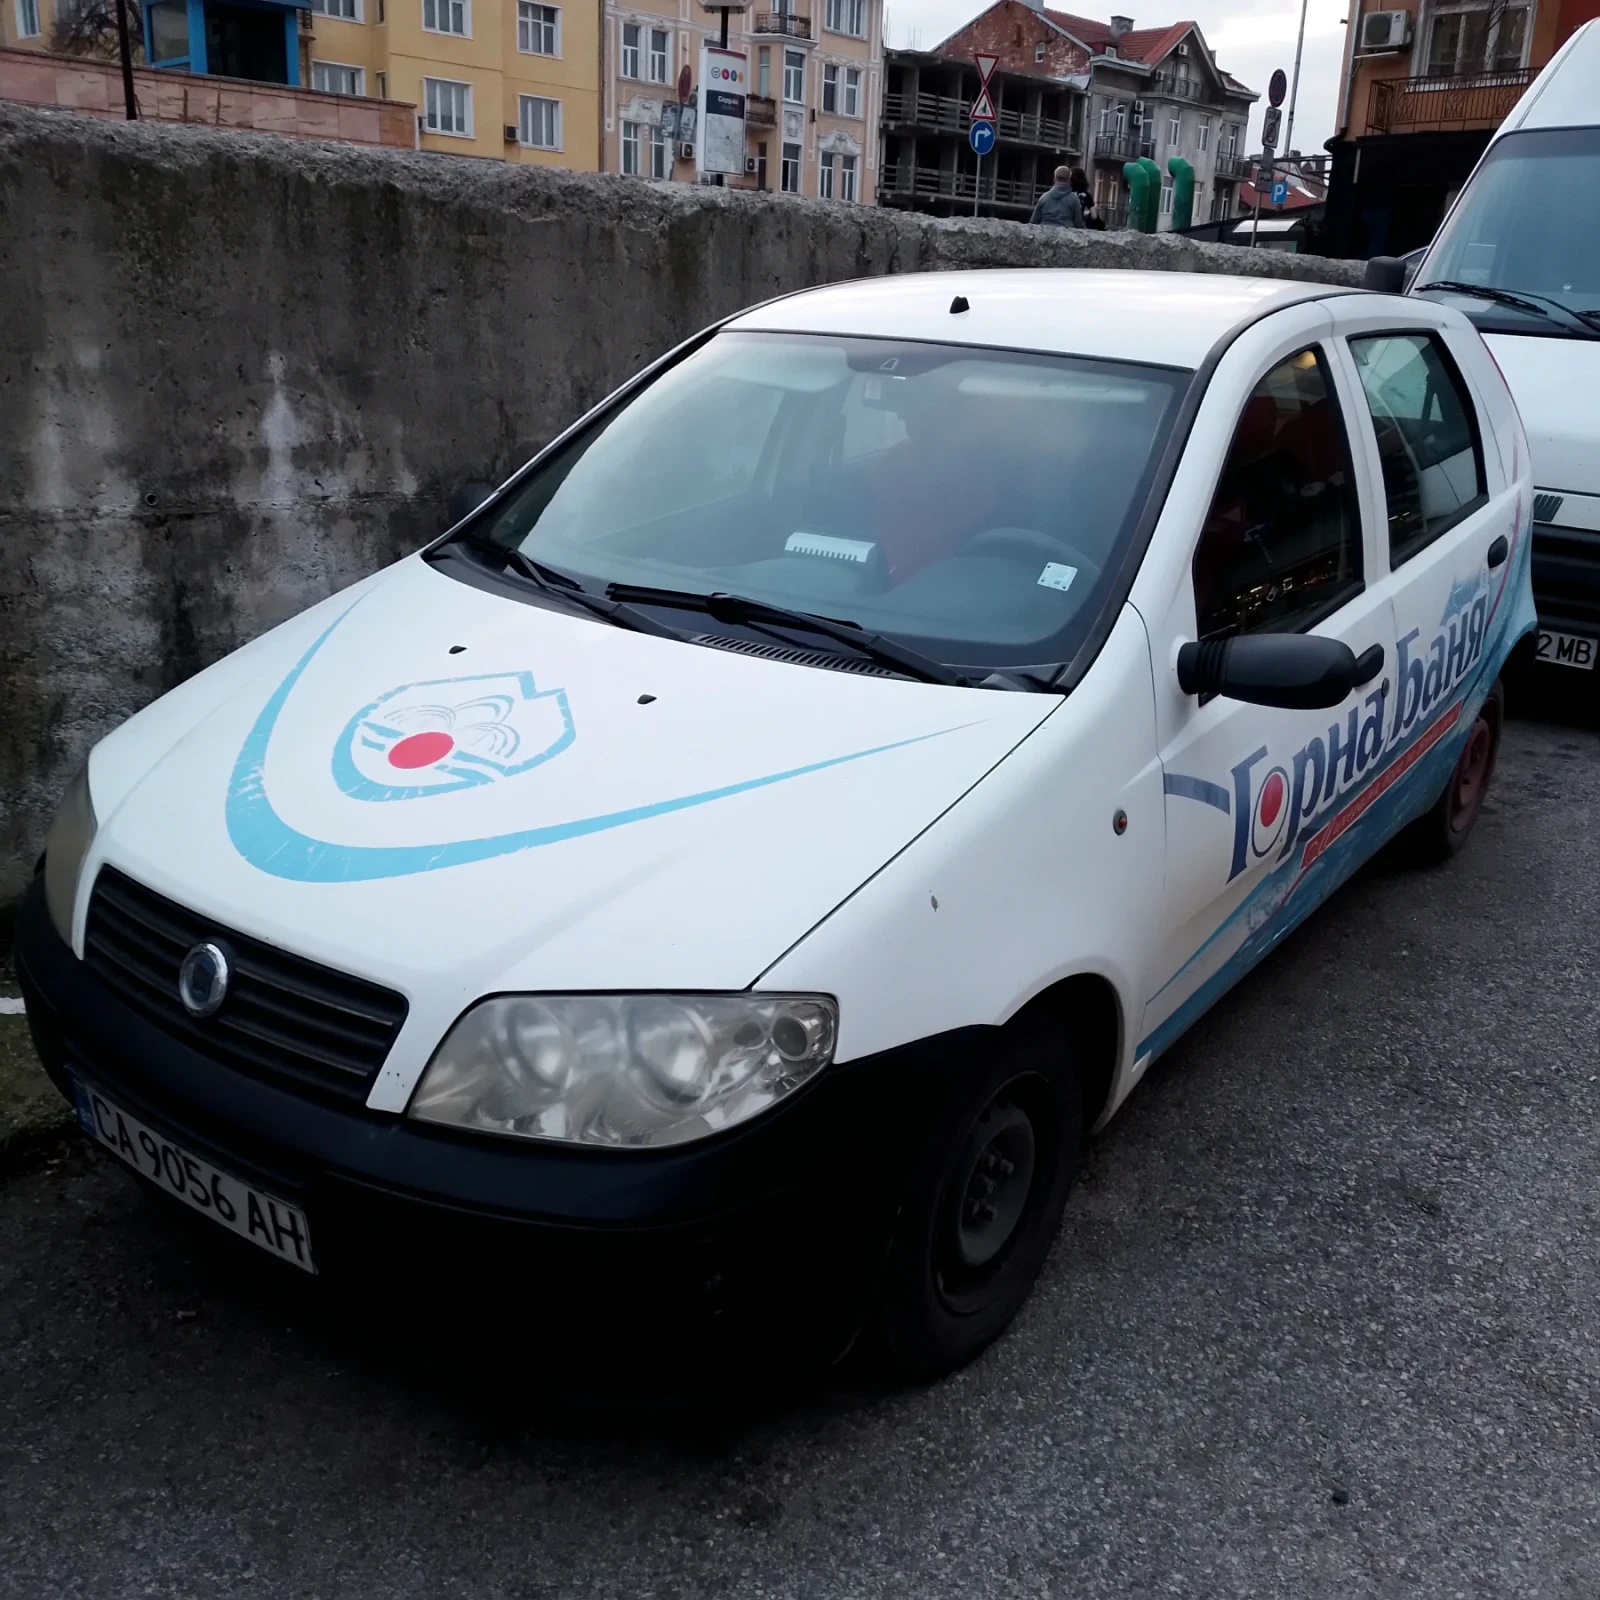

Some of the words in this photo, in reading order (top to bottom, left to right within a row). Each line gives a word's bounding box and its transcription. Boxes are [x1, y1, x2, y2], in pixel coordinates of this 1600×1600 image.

[1274, 184, 1285, 200] P
[1226, 686, 1387, 885] Горна
[1389, 594, 1488, 742] Баня
[93, 1094, 139, 1165] CA
[140, 1130, 236, 1222] 9056
[247, 1190, 305, 1263] AH
